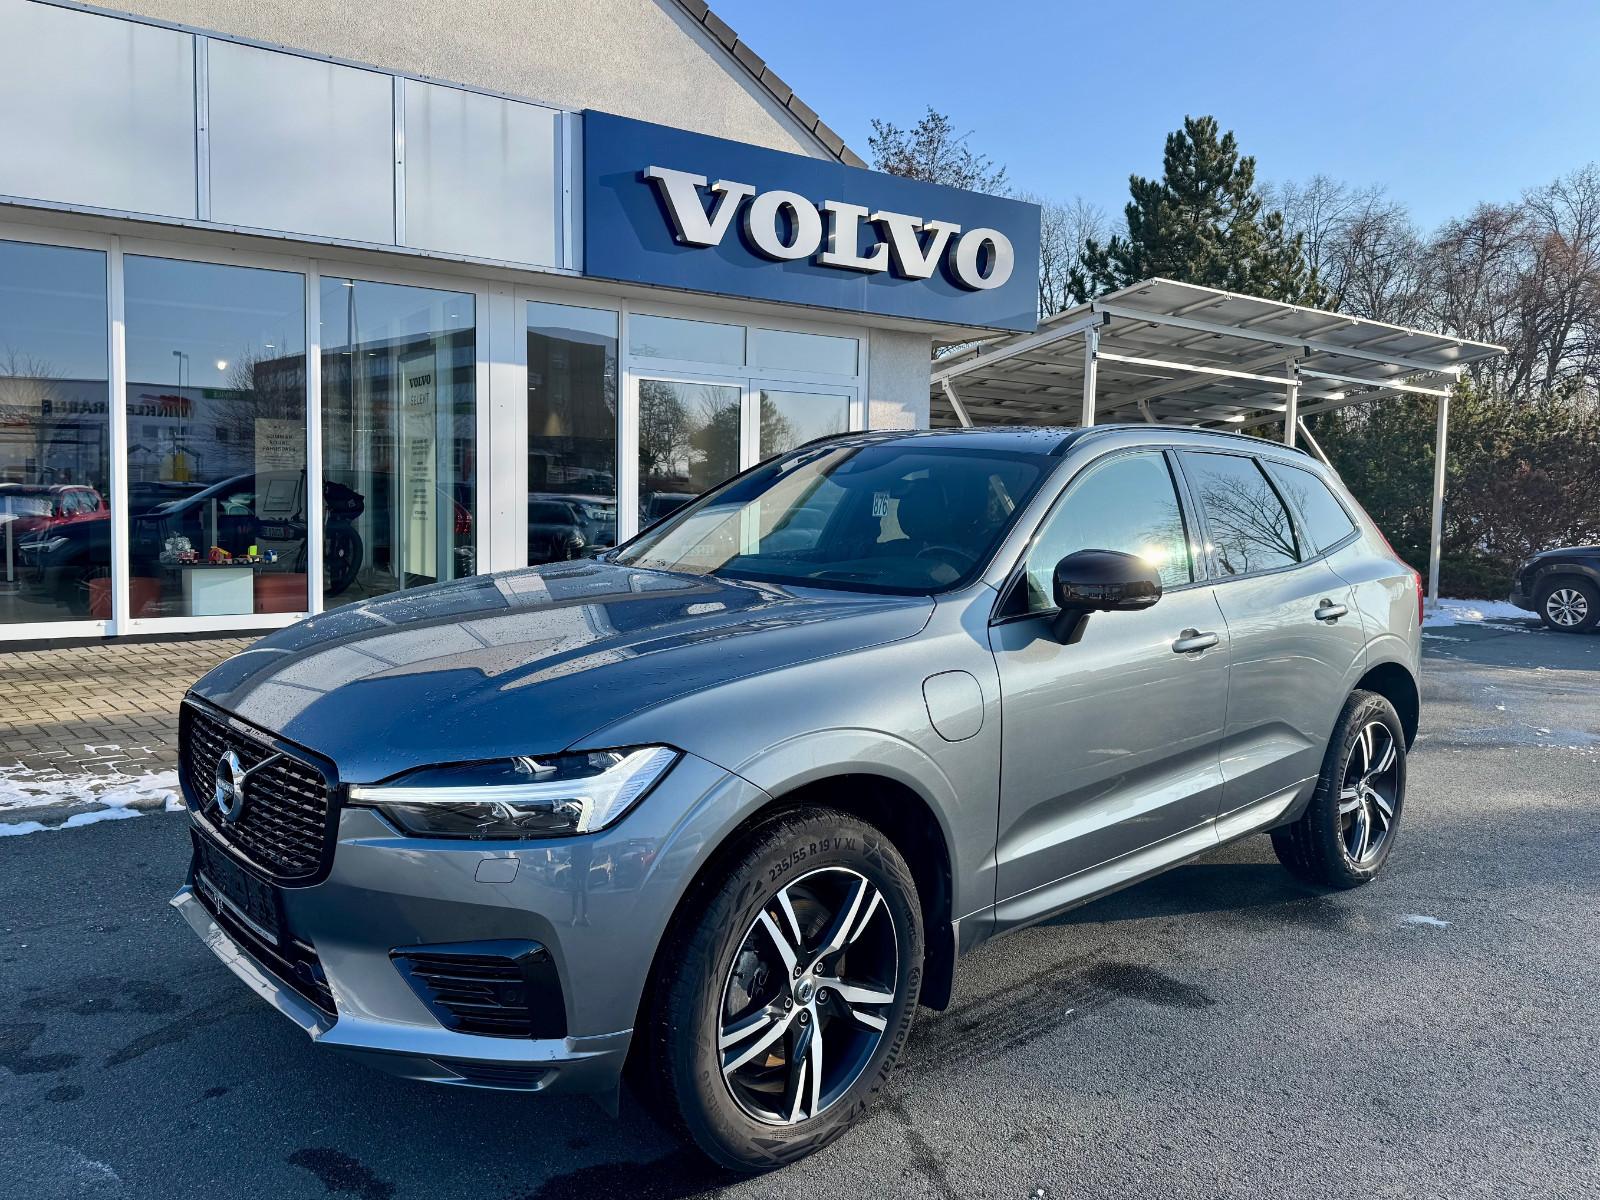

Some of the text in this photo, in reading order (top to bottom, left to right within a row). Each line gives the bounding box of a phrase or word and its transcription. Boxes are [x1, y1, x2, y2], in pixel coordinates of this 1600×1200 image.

[643, 165, 1015, 290] VOLVO
[409, 374, 431, 388] VOLVO
[874, 495, 888, 515] 876
[769, 837, 856, 882] 235/55 R 19 V XL
[876, 966, 921, 1082] Continental
